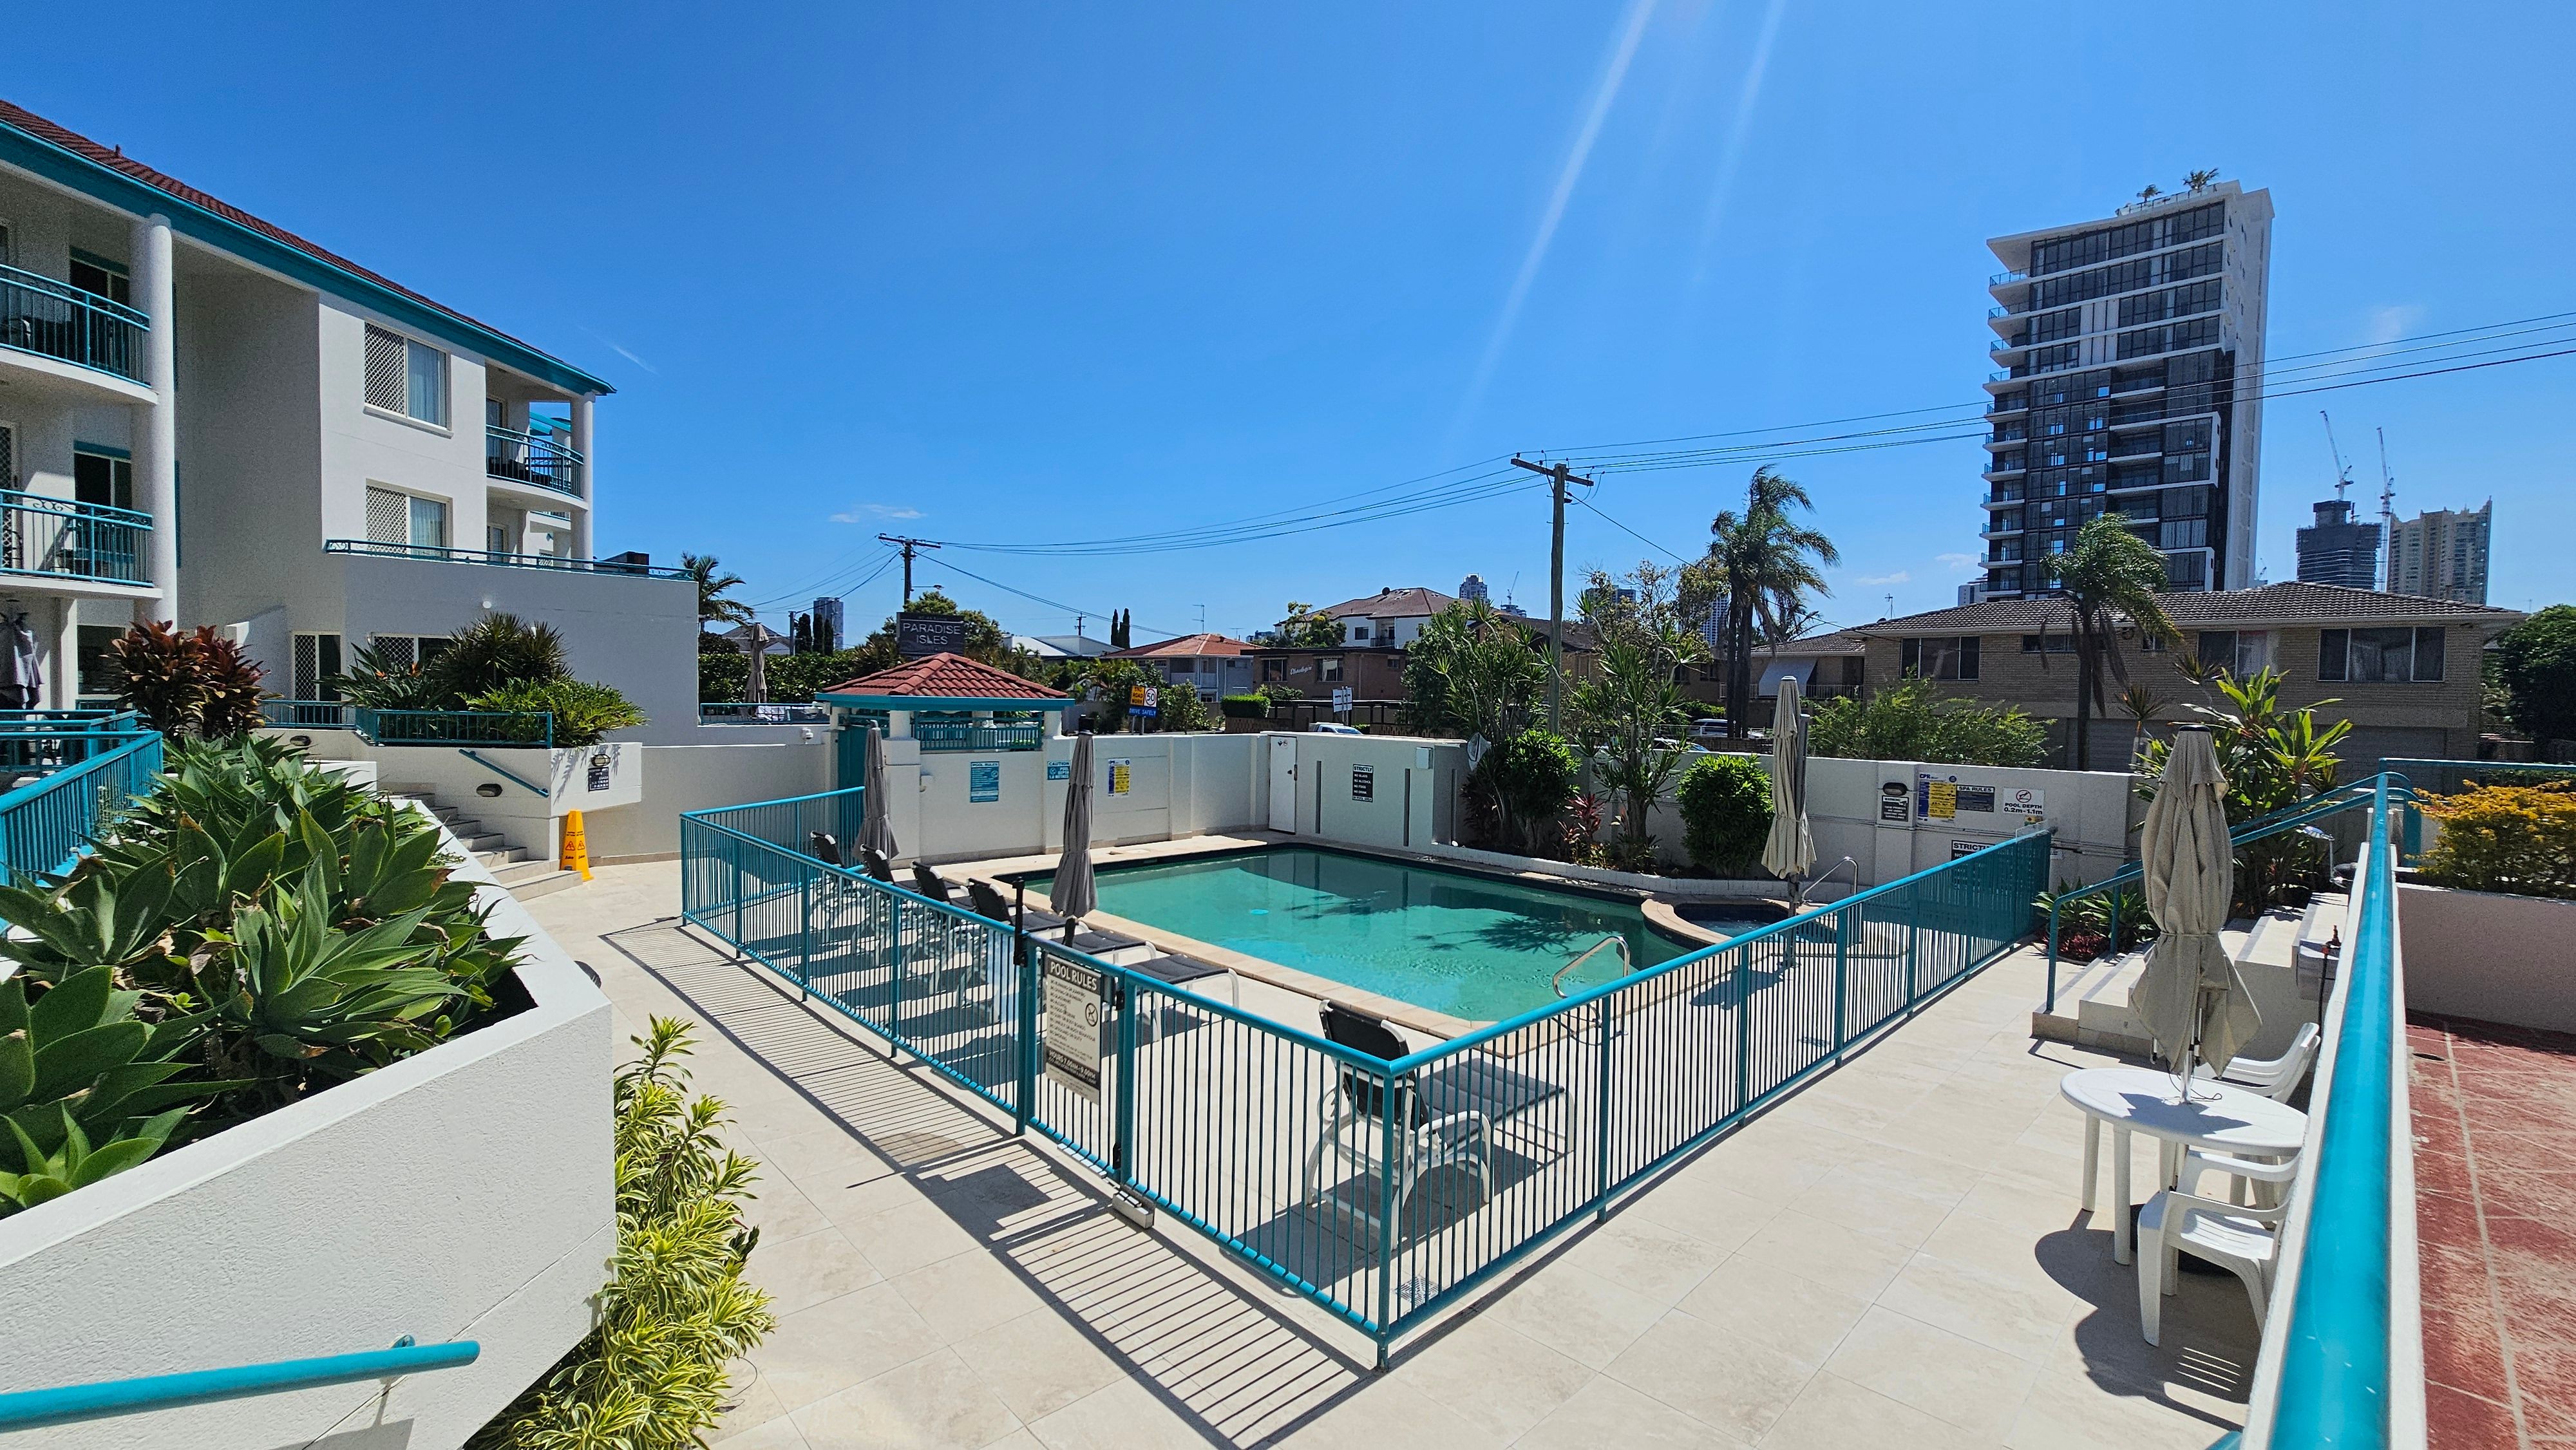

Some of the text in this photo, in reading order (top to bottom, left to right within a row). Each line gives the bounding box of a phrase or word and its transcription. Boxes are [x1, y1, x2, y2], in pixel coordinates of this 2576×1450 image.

[903, 623, 961, 634] PARADISE
[916, 635, 948, 645] ISLES
[1147, 693, 1155, 701] 50
[1050, 961, 1097, 990] POOL RULES
